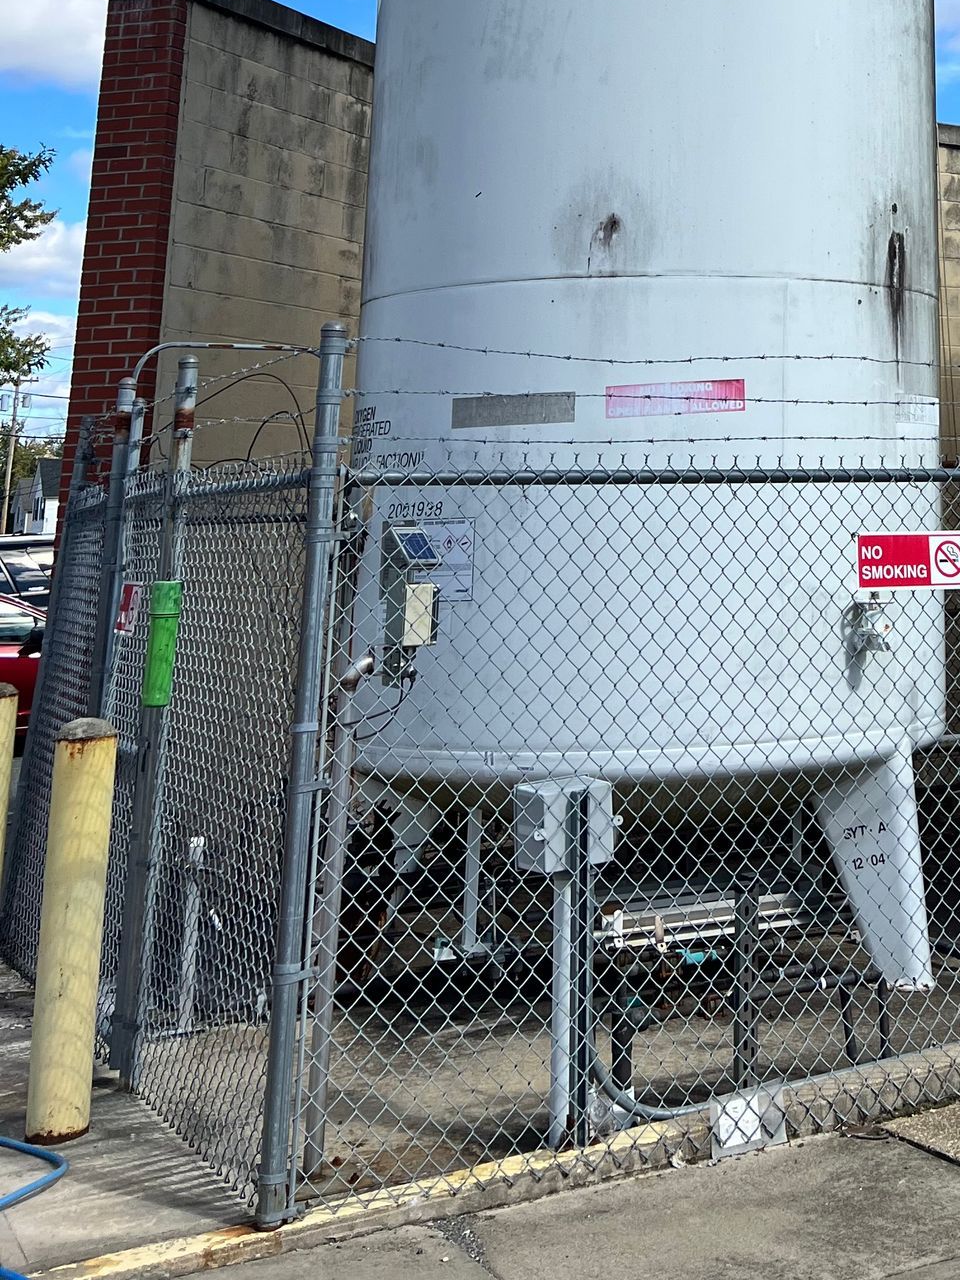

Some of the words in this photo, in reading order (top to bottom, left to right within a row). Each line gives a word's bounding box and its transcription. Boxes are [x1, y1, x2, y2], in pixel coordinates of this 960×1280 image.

[690, 400, 744, 411] ALLOWED
[861, 545, 883, 560] NO
[861, 564, 928, 580] SMOKING
